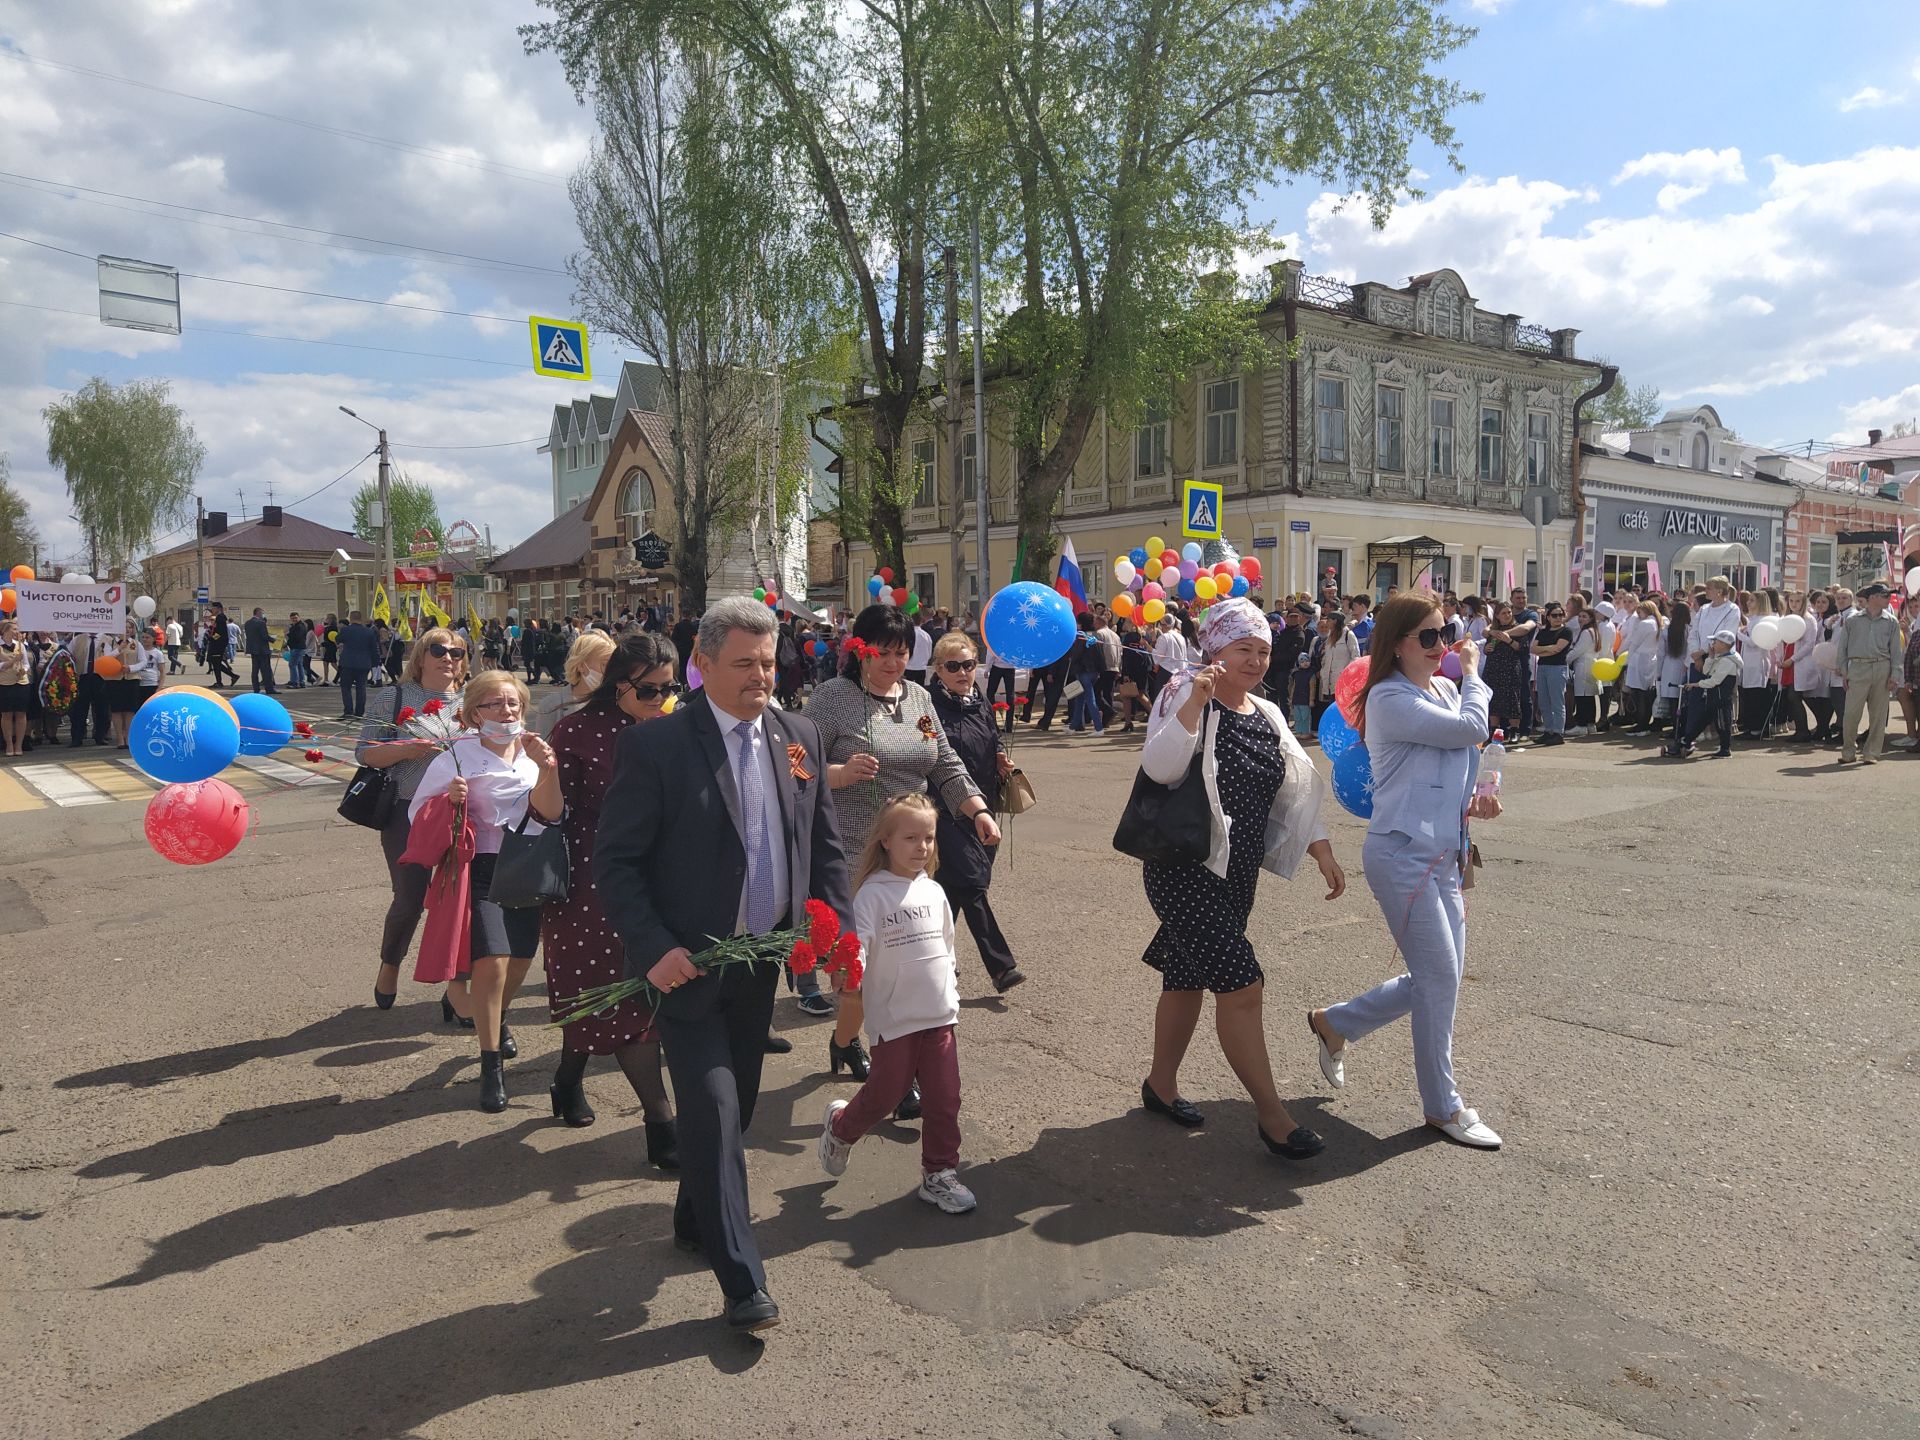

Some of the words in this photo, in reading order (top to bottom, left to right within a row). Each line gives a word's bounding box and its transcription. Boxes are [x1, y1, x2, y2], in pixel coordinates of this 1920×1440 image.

[1623, 511, 1649, 530] café
[1663, 510, 1728, 541] AVENUE
[21, 590, 102, 603] Чистополь
[52, 611, 113, 621] документы
[147, 737, 176, 759] 9
[887, 905, 932, 927] SUNSET
